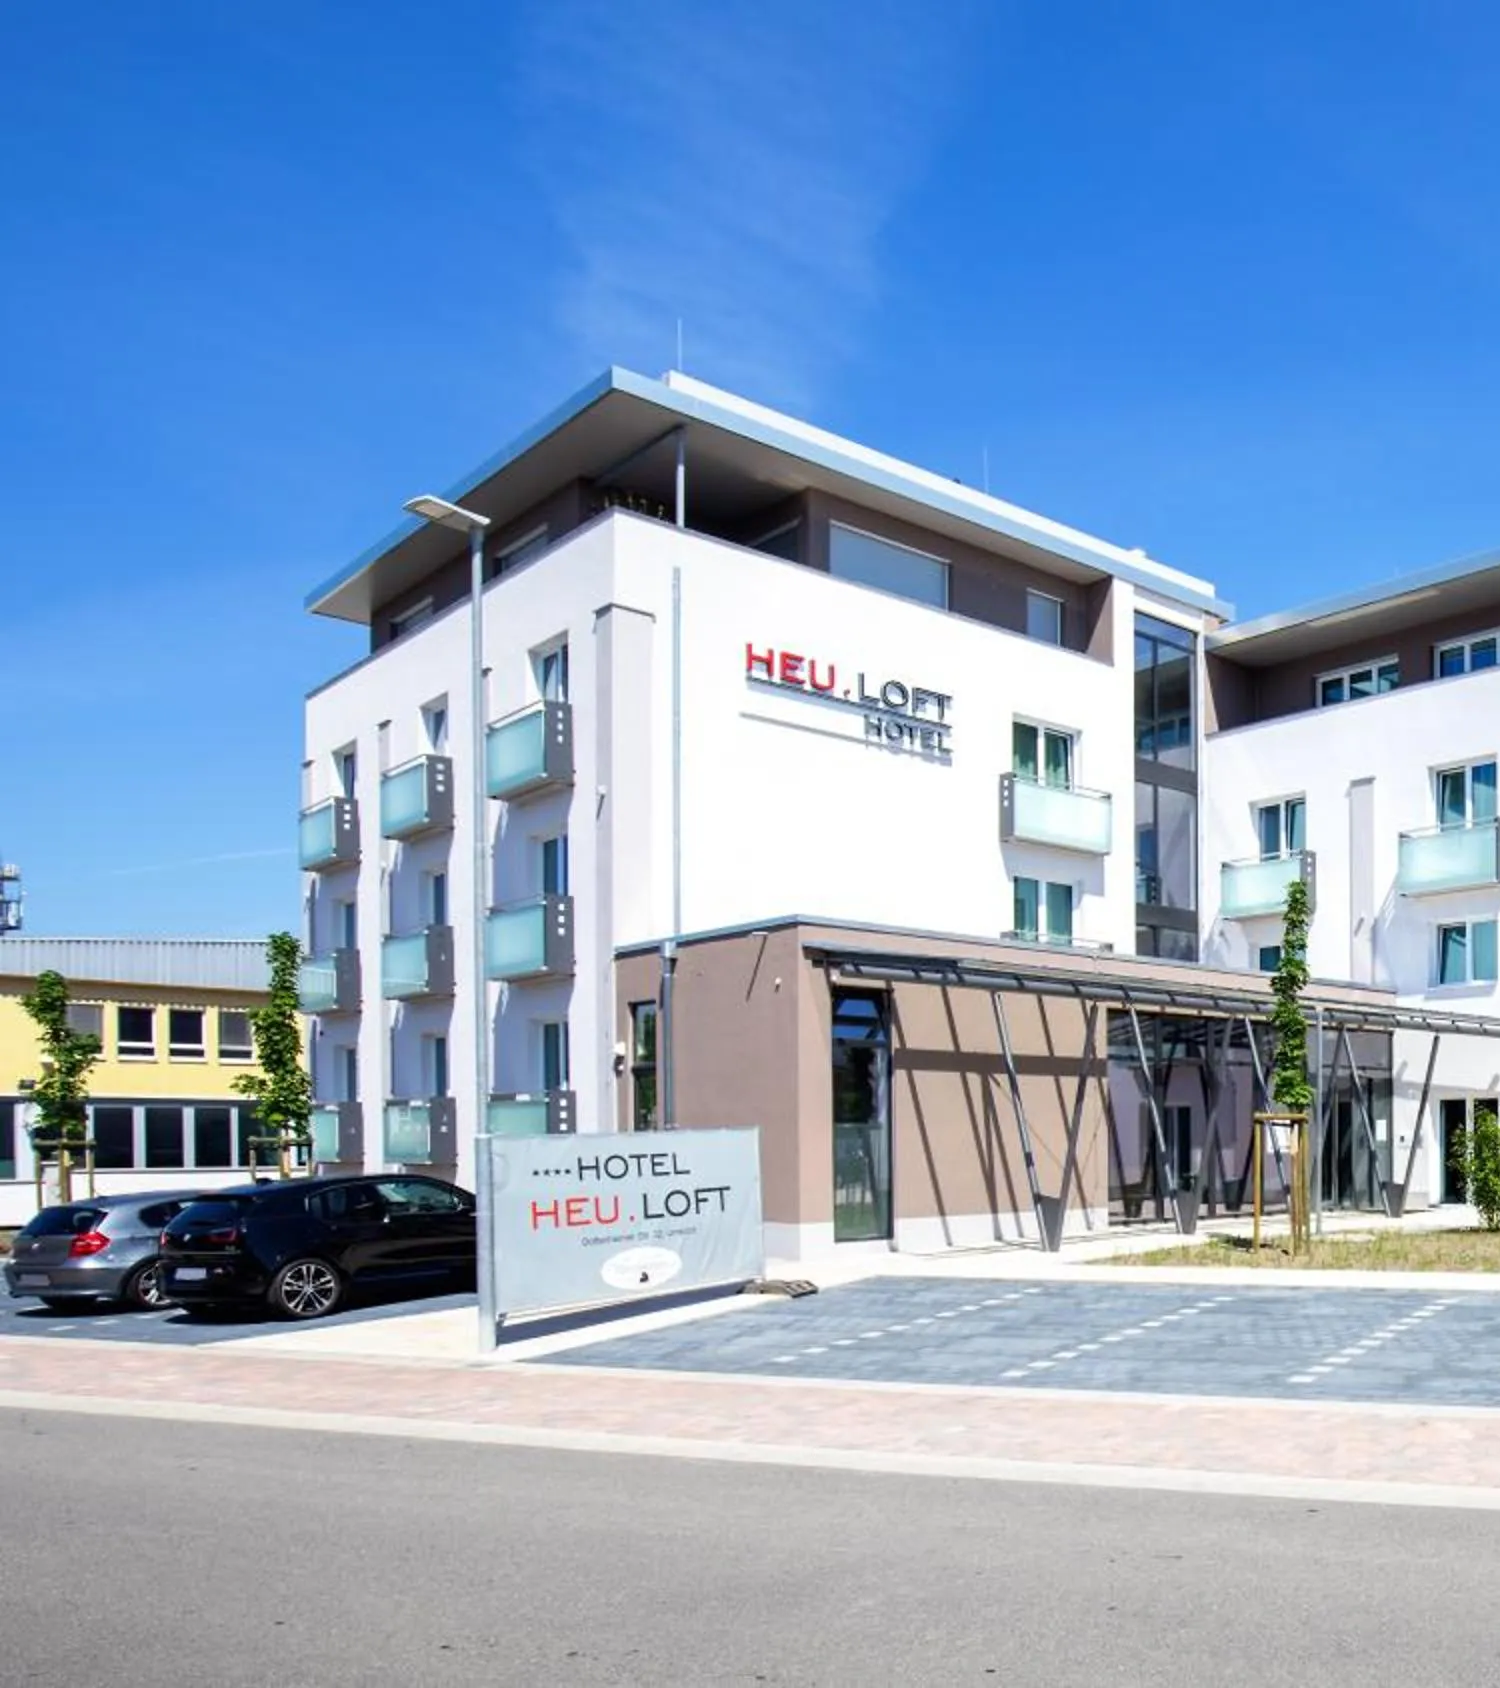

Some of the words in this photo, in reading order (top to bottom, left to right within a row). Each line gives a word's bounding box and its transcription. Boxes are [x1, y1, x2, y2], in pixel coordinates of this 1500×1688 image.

[857, 672, 953, 721] LOFT
[863, 713, 953, 755] HOTEL
[577, 1153, 691, 1181] HOTEL
[643, 1186, 731, 1220] LOFT
